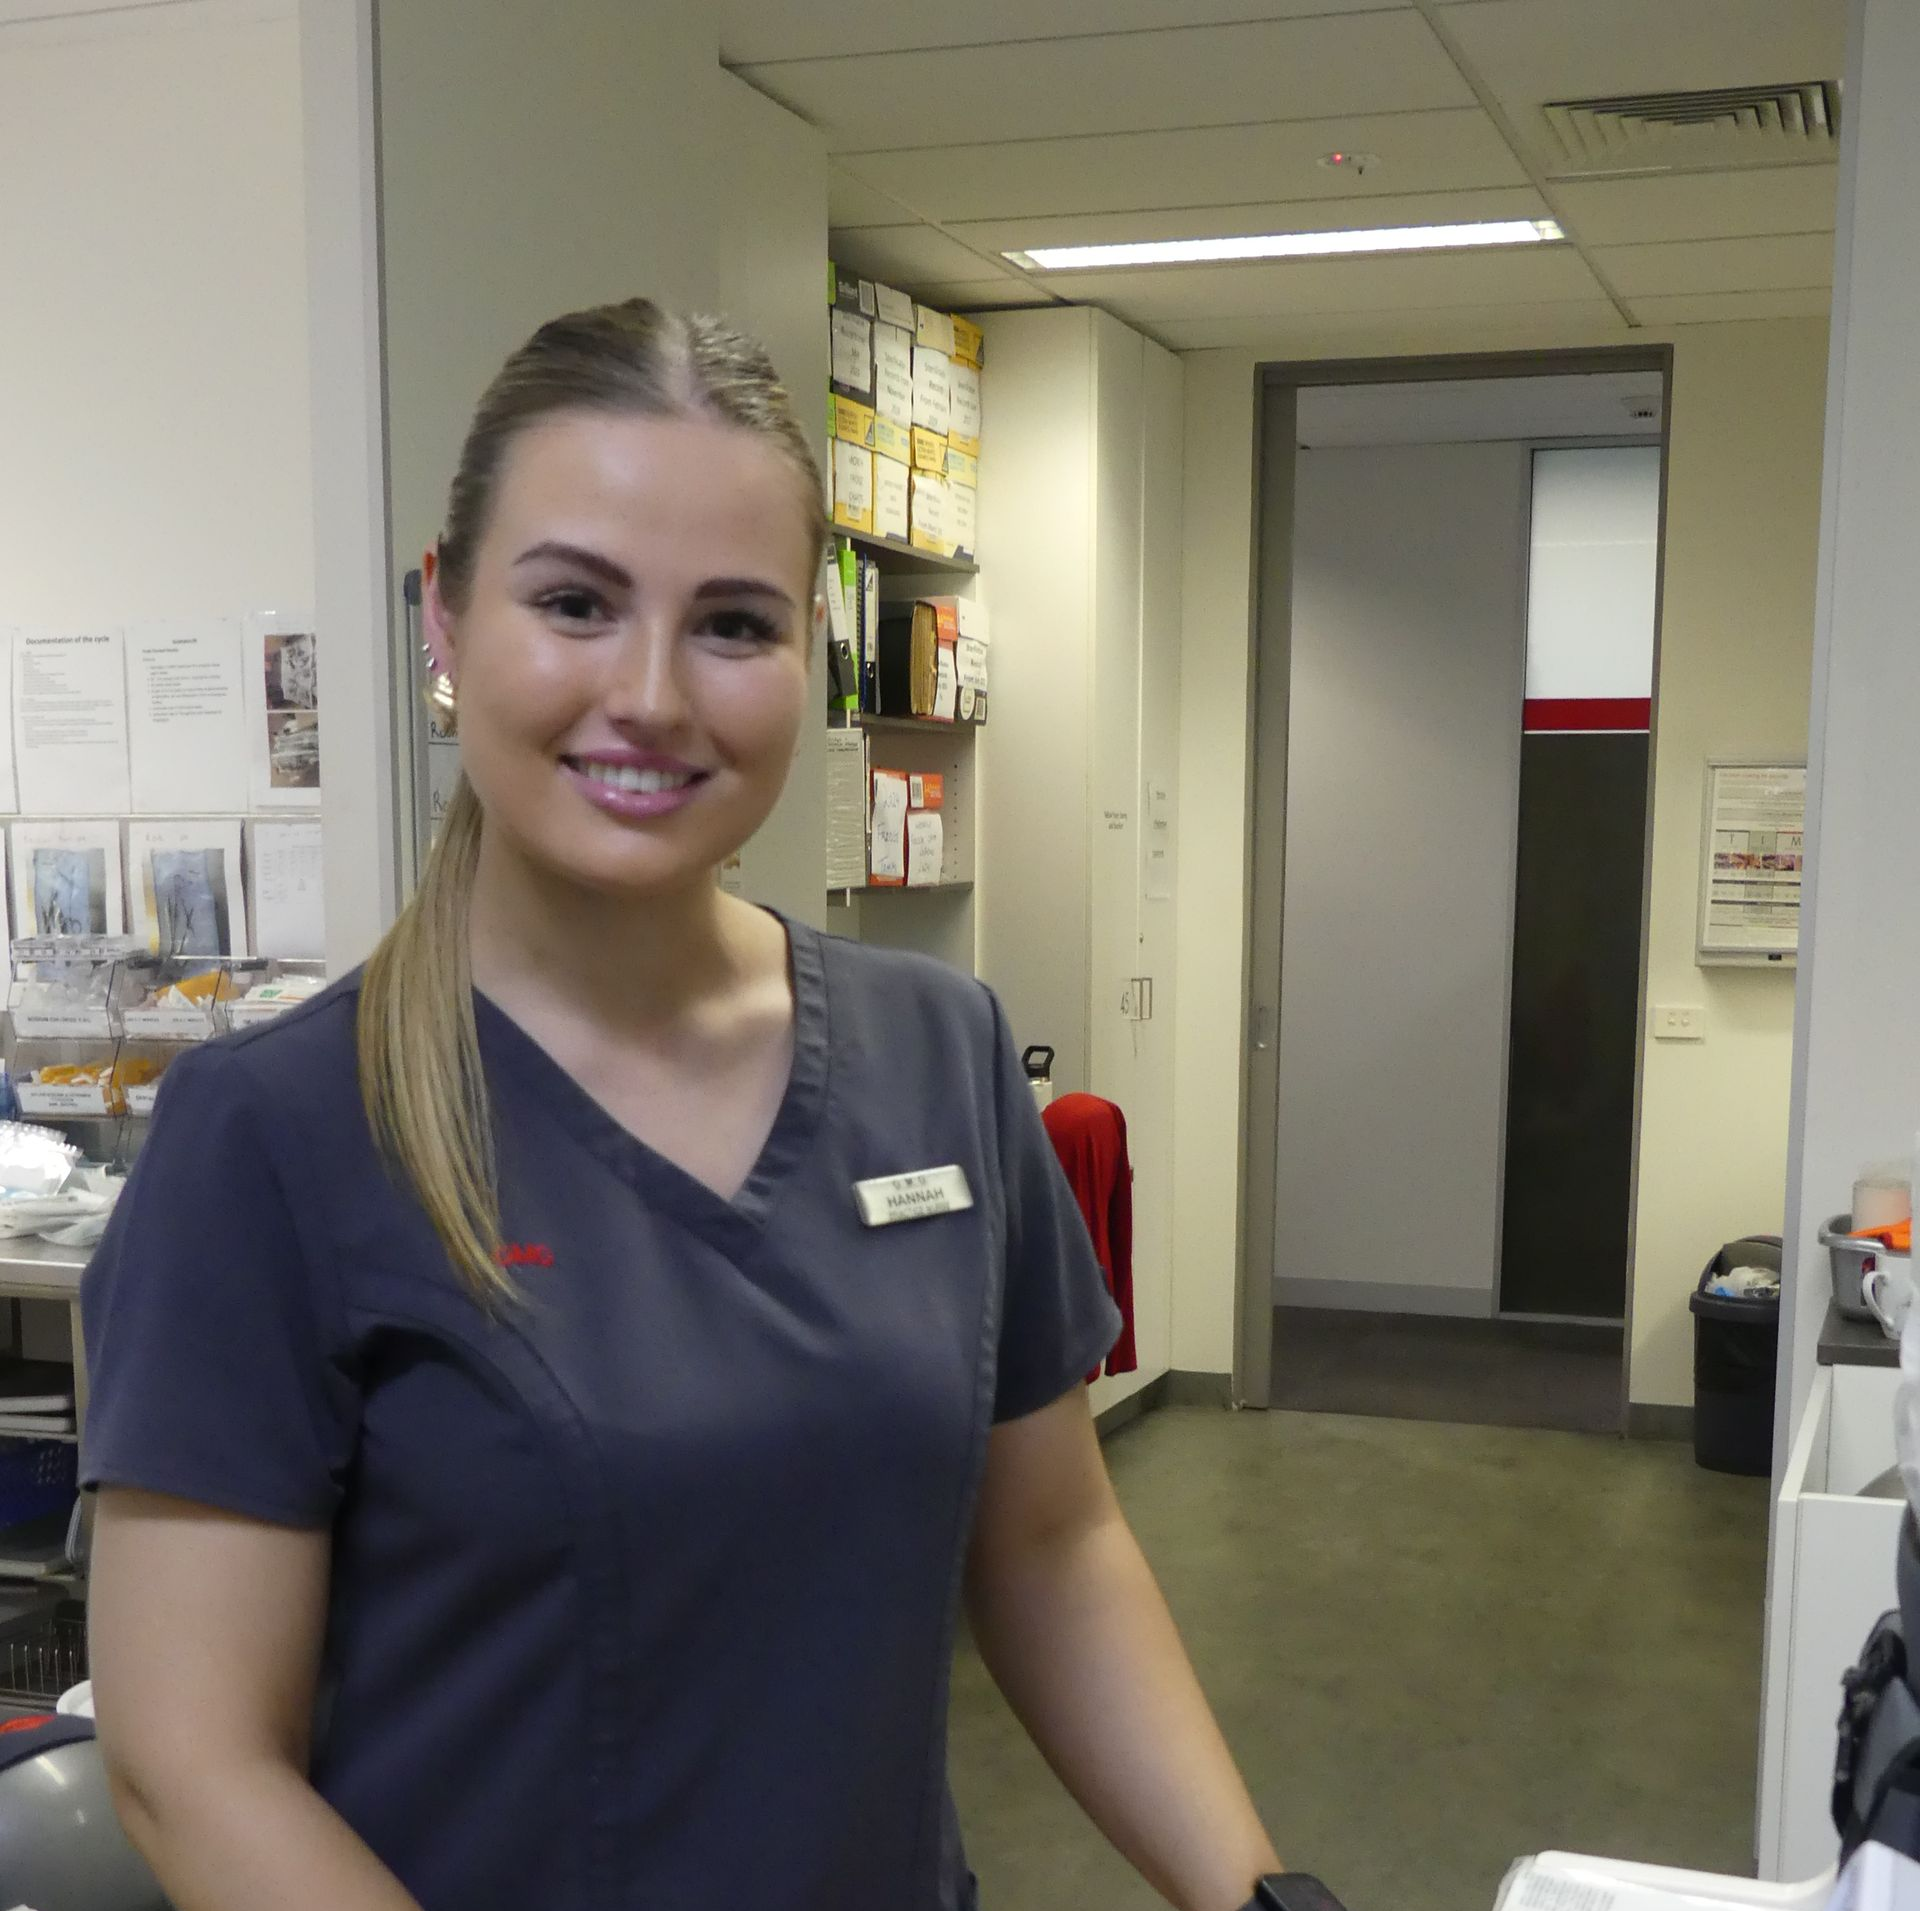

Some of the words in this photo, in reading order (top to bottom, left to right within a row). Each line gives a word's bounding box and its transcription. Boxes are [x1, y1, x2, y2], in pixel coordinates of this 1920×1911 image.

[26, 636, 73, 645] Documentation
[75, 635, 81, 644] of
[83, 635, 92, 643] the
[94, 635, 110, 645] cycle
[1791, 836, 1801, 846] M
[886, 1187, 945, 1207] HANNAH
